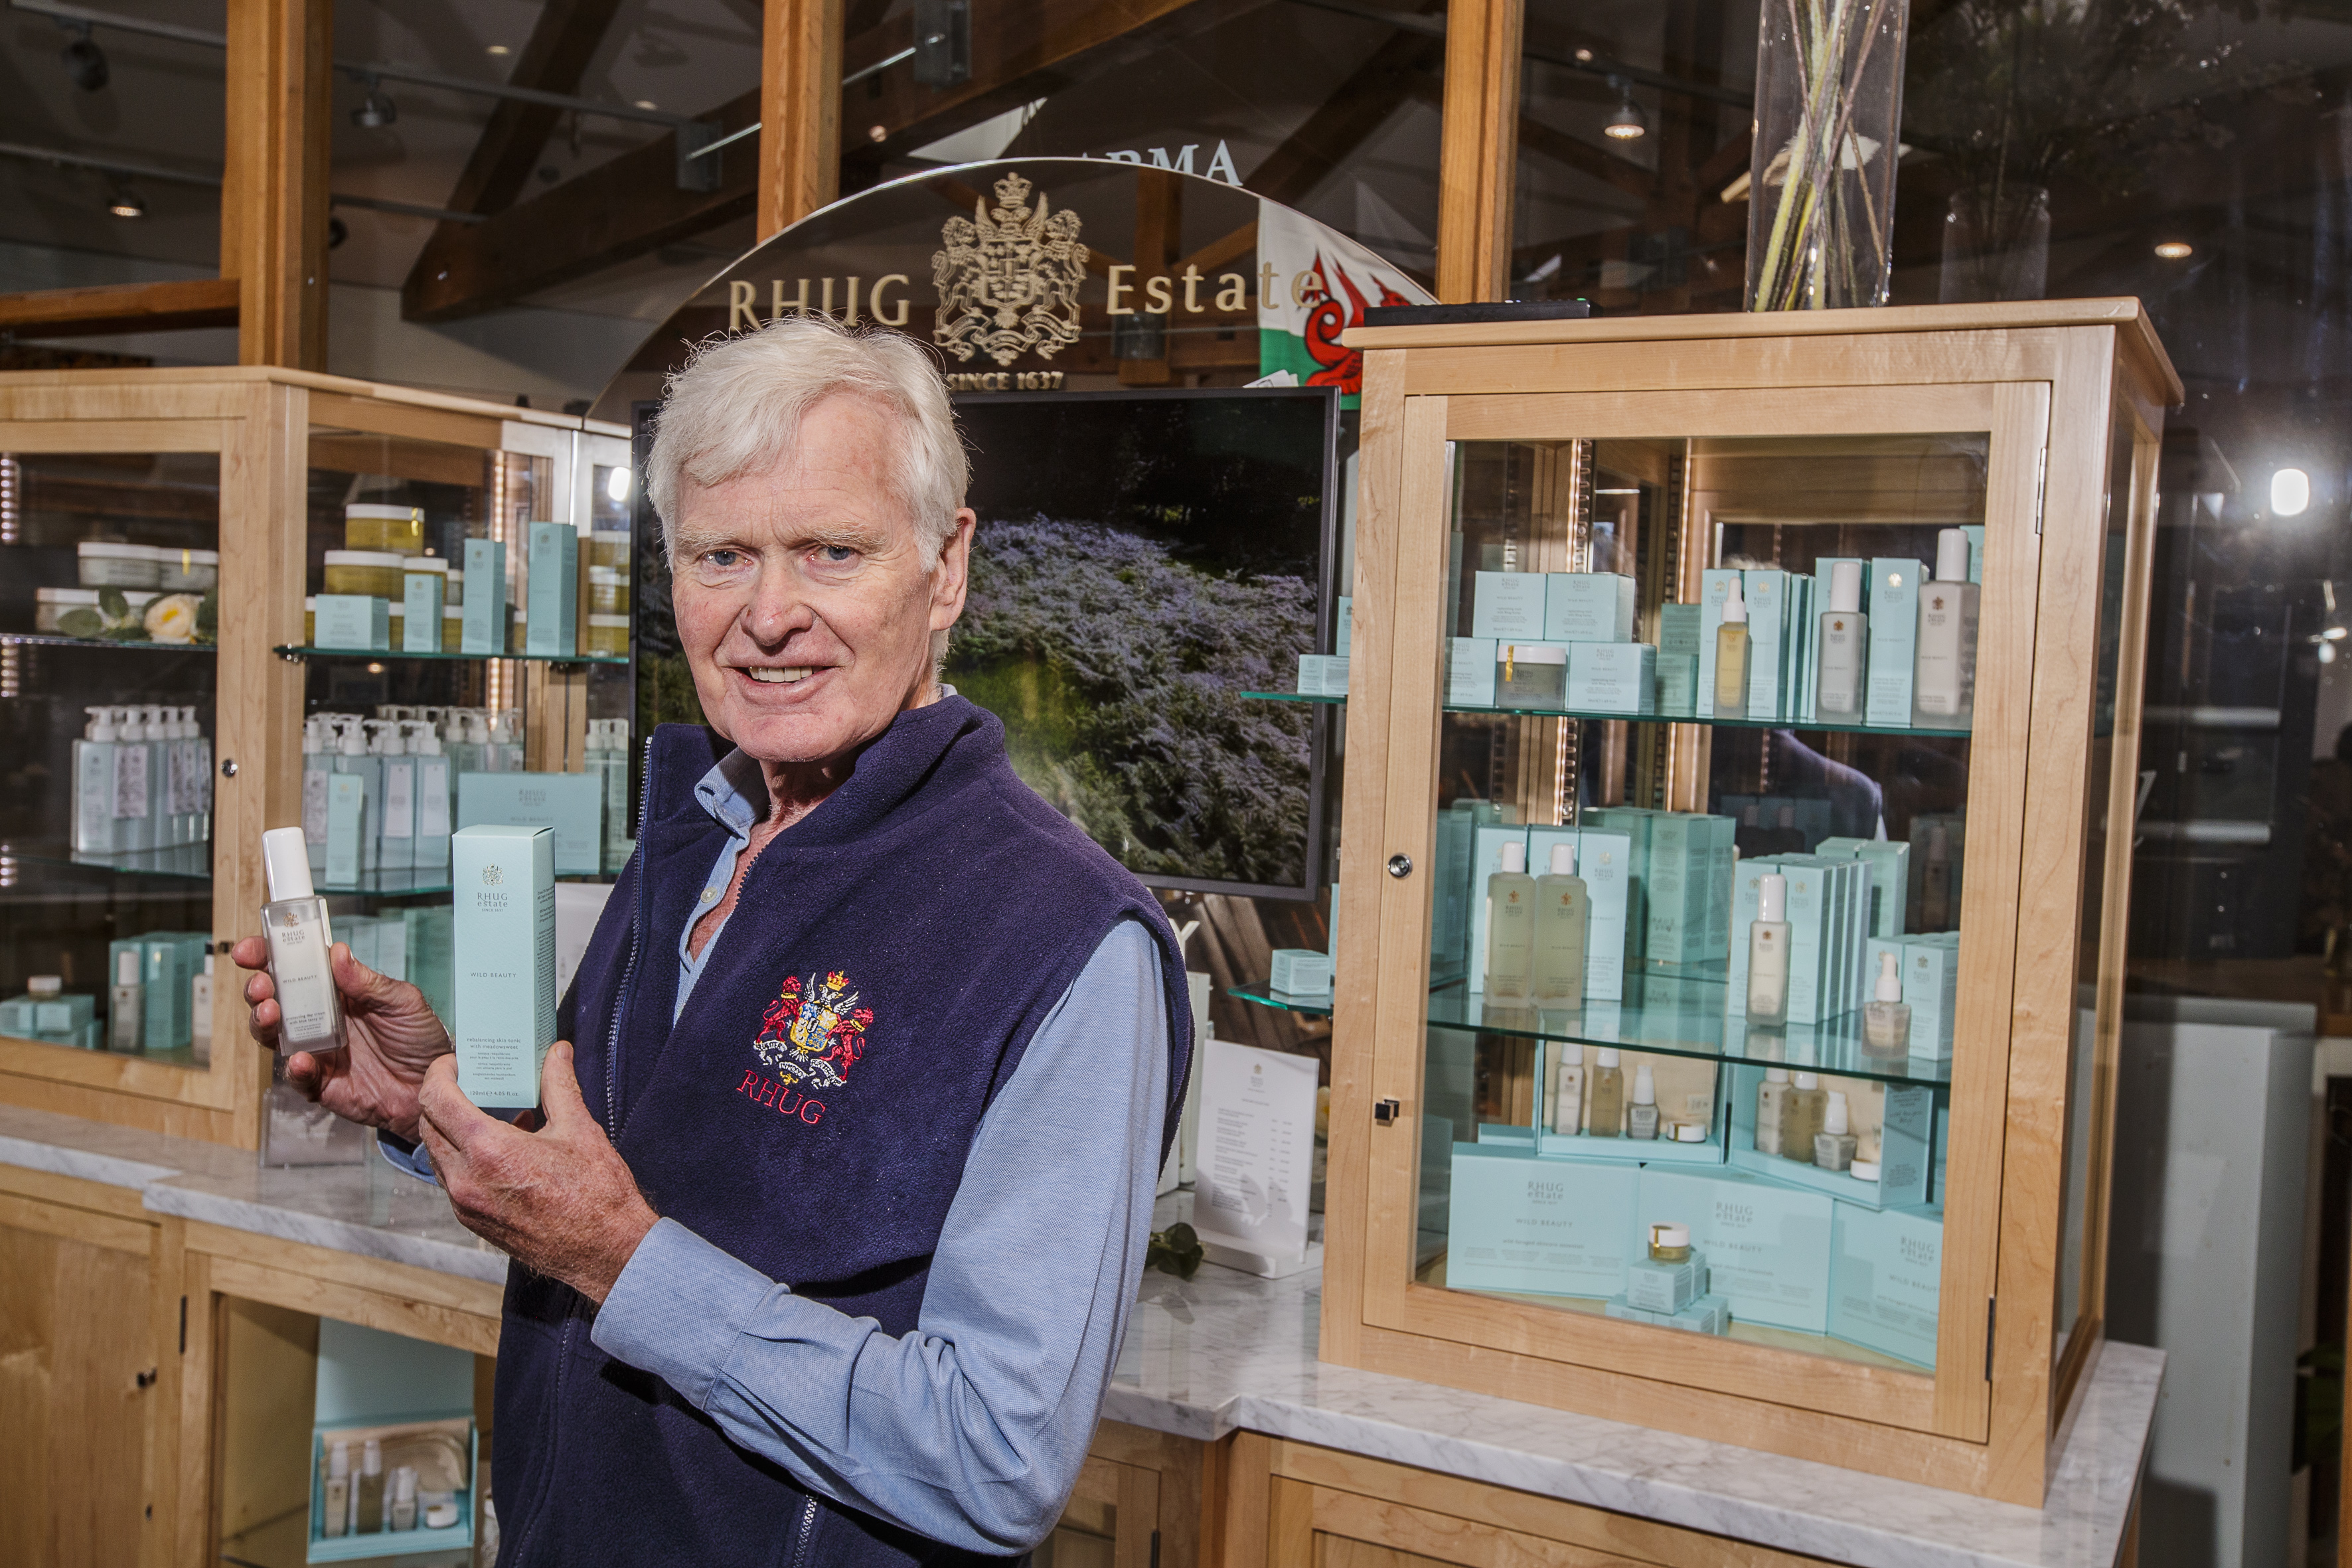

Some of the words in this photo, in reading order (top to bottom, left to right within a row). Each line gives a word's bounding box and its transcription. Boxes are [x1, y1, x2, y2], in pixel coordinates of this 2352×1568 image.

[729, 274, 910, 331] RHUG
[1106, 260, 1324, 315] Estate
[946, 372, 1010, 391] SINCE
[1016, 370, 1064, 390] 1637
[477, 892, 508, 902] RHUG
[282, 929, 305, 938] RHUG
[736, 1069, 826, 1124] RHUG
[1528, 1181, 1564, 1192] RHUG
[1716, 1202, 1754, 1216] RHUG
[1516, 1217, 1537, 1226] WILD
